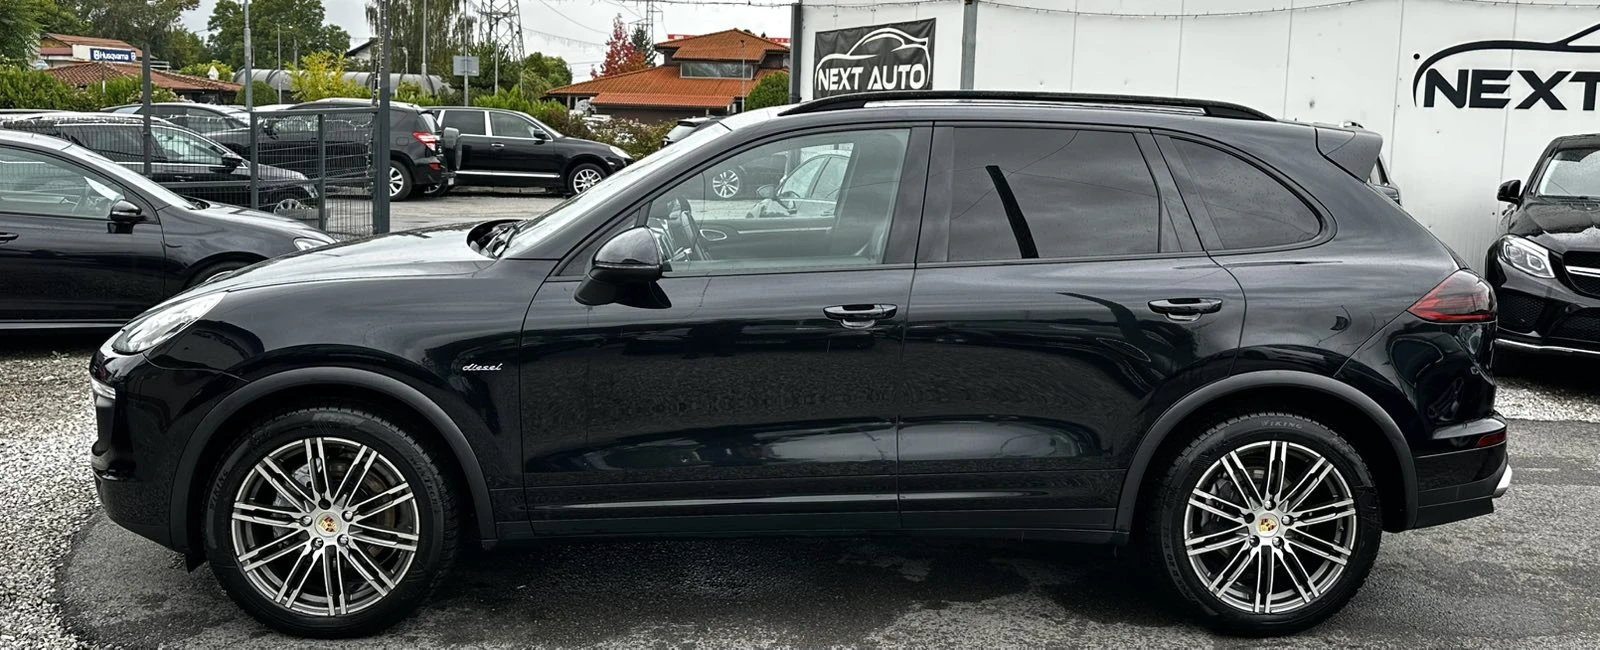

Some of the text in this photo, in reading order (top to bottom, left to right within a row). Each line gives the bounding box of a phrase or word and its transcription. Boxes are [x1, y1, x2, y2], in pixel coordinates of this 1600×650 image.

[818, 63, 926, 91] NEXT AUTO
[1423, 68, 1600, 111] NEXT
[462, 362, 503, 371] diesel
[1262, 420, 1303, 429] VIKING
